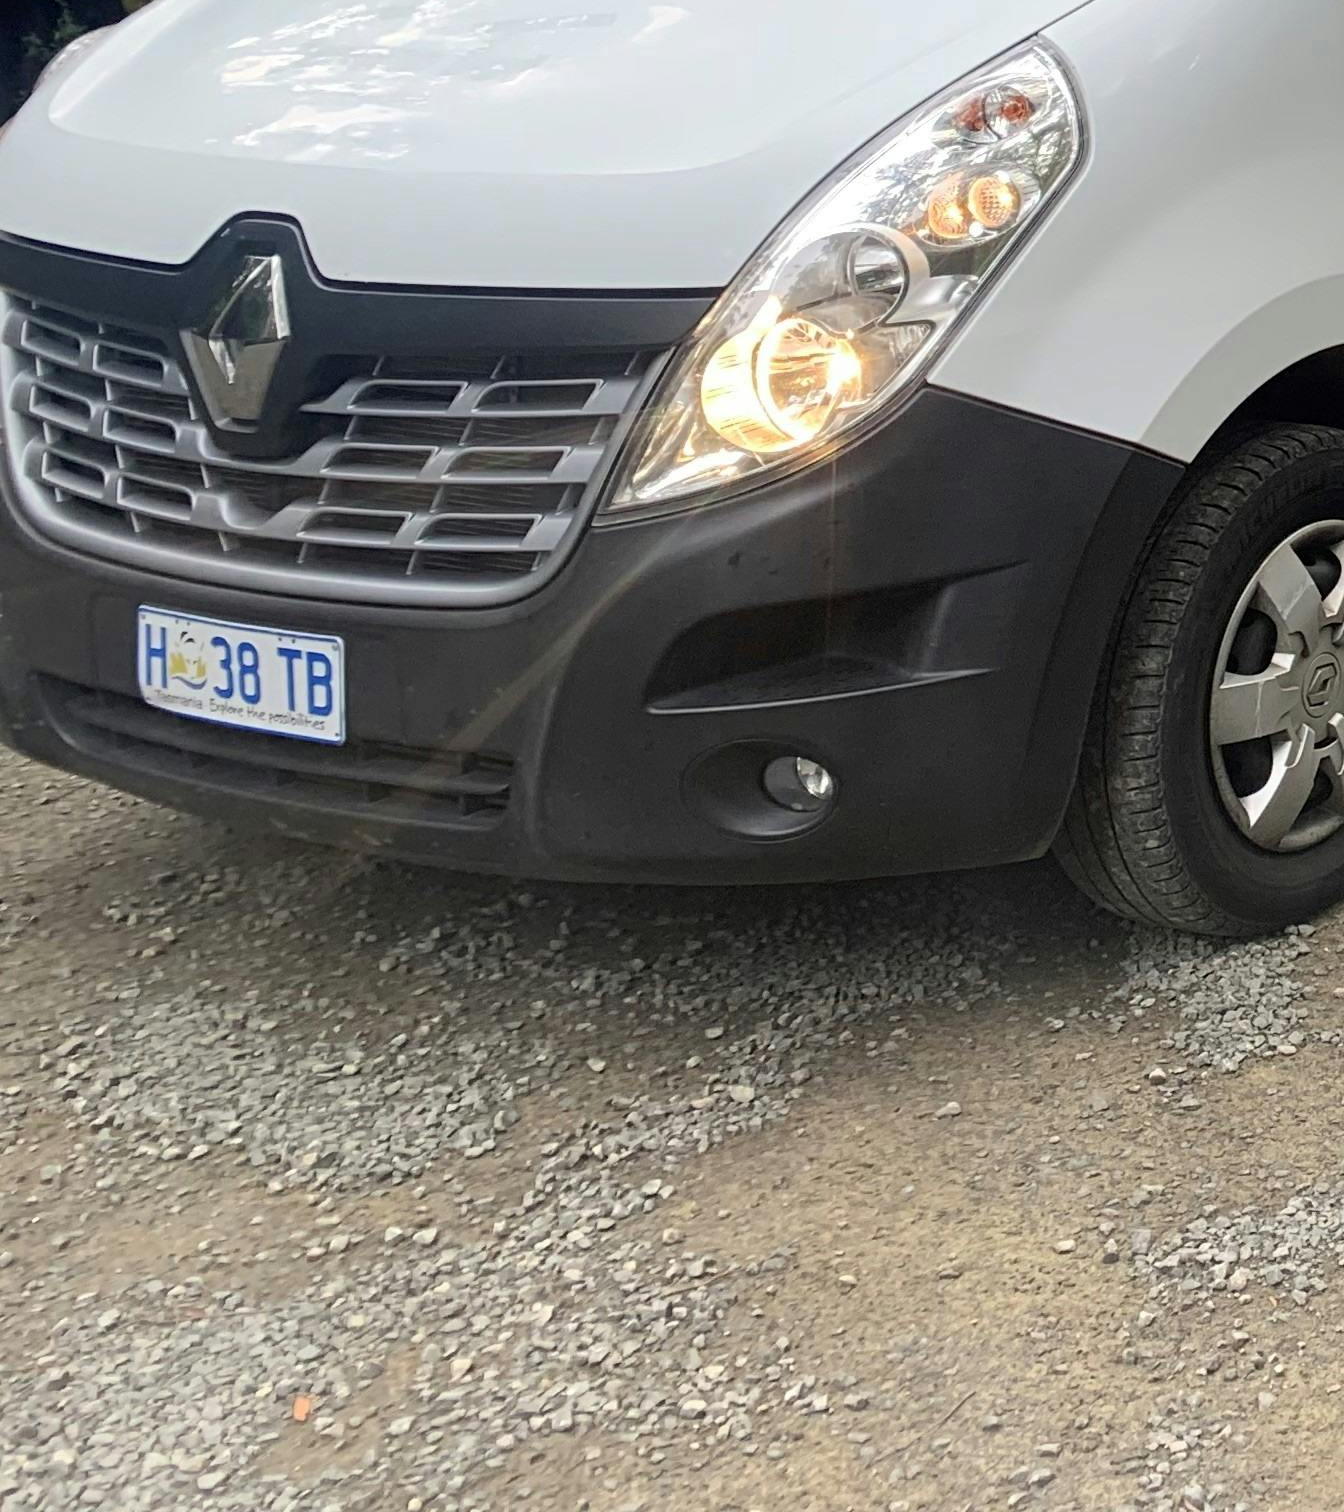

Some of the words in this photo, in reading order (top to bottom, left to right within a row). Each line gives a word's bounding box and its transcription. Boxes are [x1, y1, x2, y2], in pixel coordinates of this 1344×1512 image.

[145, 623, 168, 689] H
[211, 636, 262, 705] 38
[277, 647, 333, 717] TB
[246, 707, 266, 721] the
[268, 712, 326, 731] possibilities
